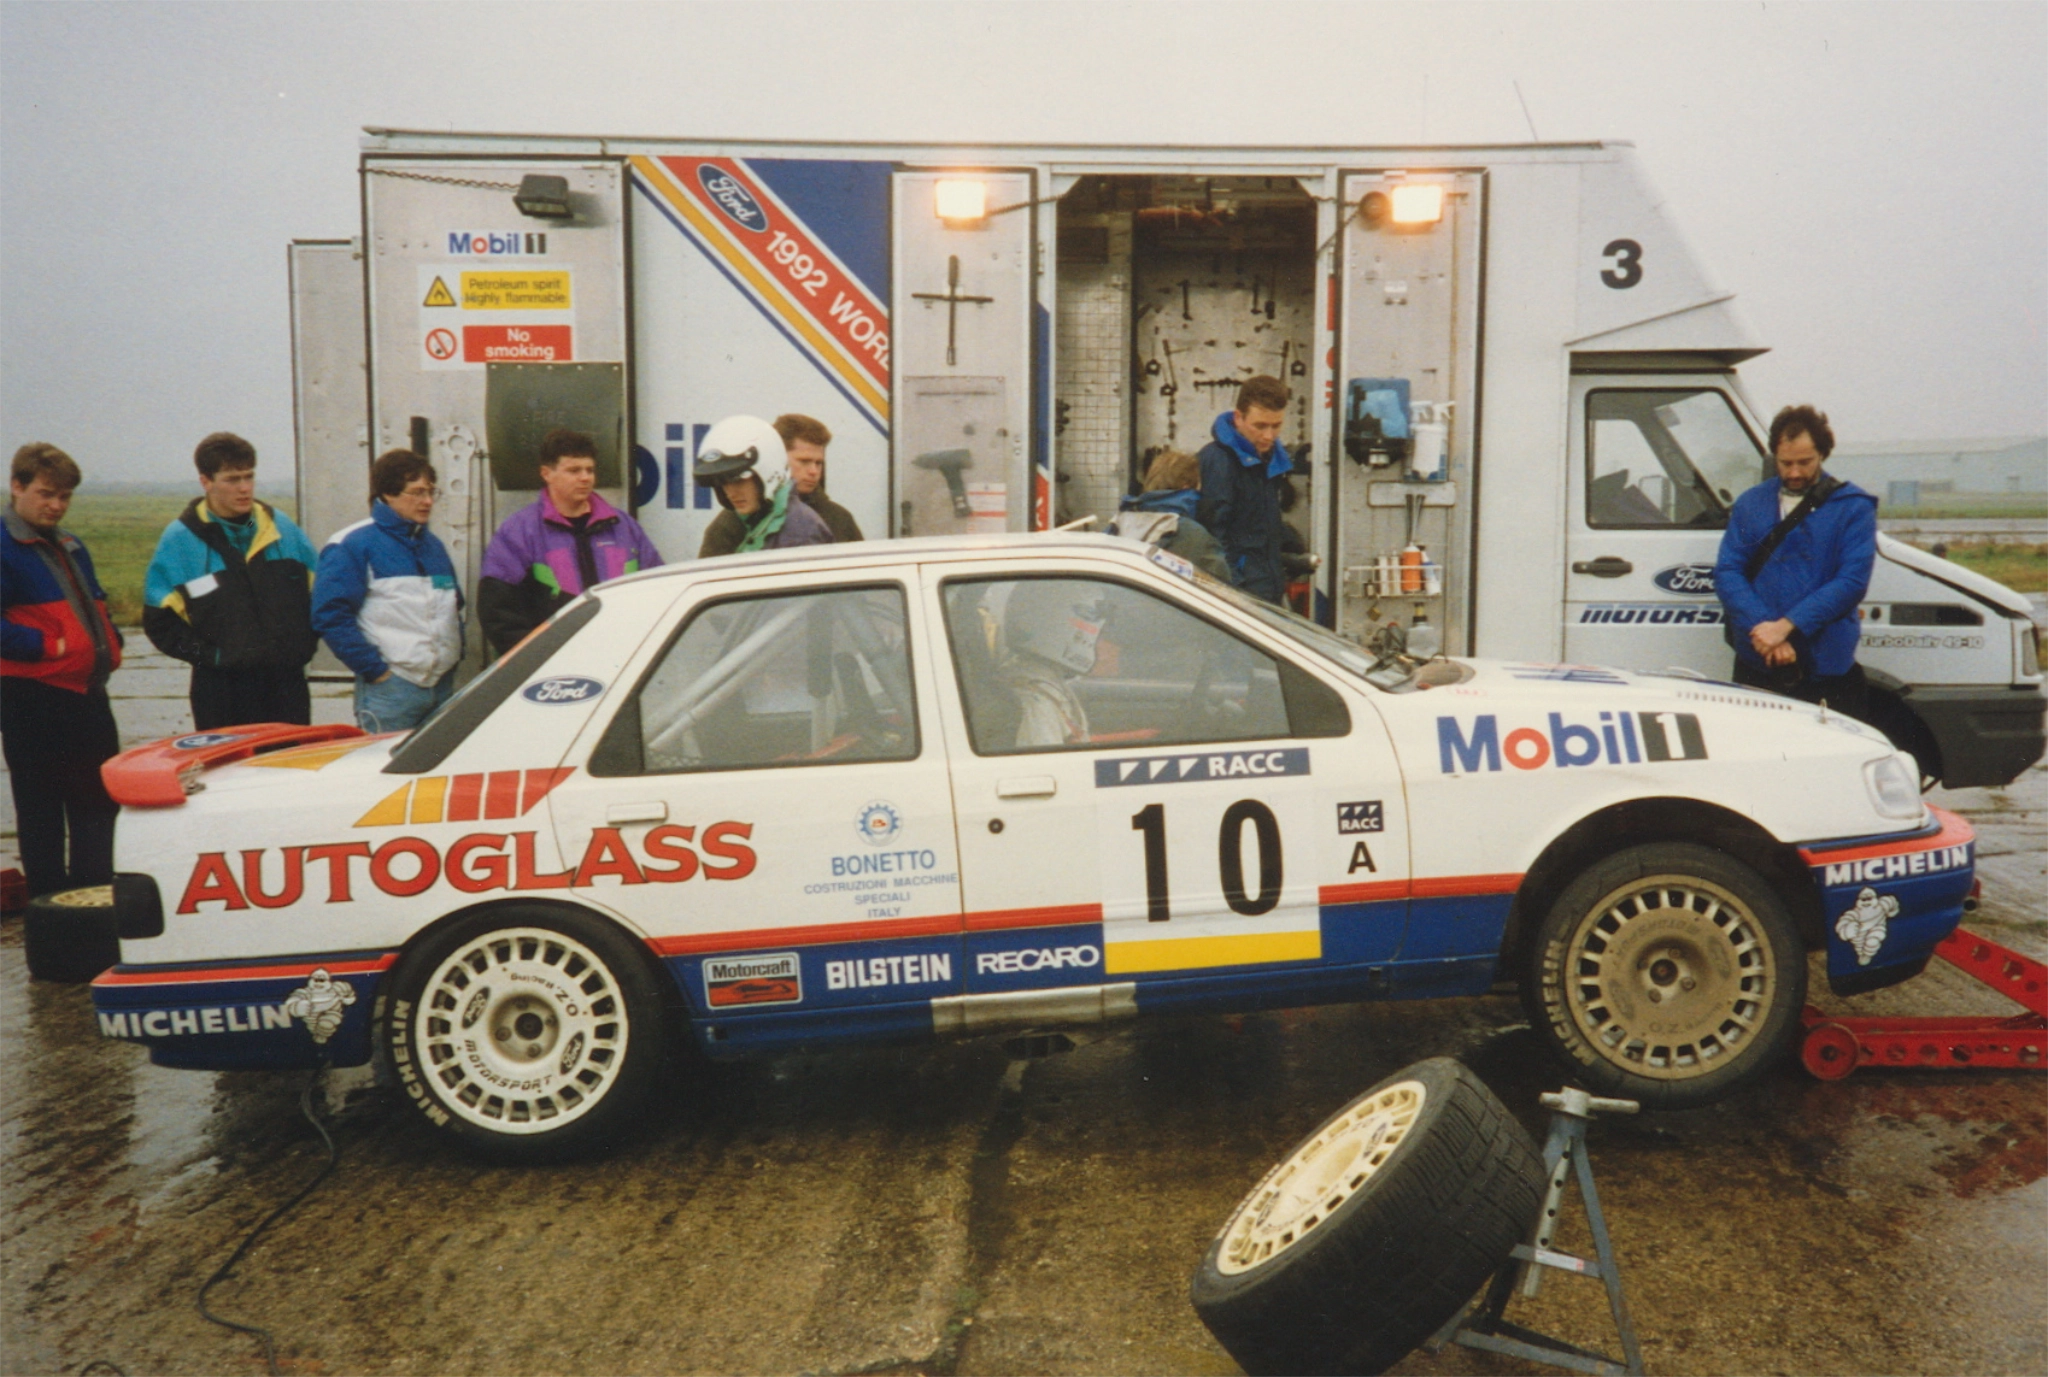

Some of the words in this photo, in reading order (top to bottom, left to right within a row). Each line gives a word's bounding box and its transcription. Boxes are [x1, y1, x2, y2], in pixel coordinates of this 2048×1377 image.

[448, 232, 519, 254] Mobil
[766, 229, 828, 297] 1992
[1600, 238, 1643, 290] 3
[468, 278, 528, 290] Petroleum
[533, 279, 562, 291] spirit
[506, 292, 566, 303] flammable
[507, 328, 530, 342] No
[485, 344, 555, 360] smoking
[536, 679, 590, 701] Ford
[1436, 711, 1641, 774] Mobil
[1207, 751, 1286, 777] RACC
[1340, 816, 1381, 831] RACC
[176, 821, 758, 915] AUTOGLASS
[831, 849, 936, 877] BONETTO
[1131, 798, 1283, 923] 10
[1347, 841, 1377, 875] A
[1825, 845, 1969, 888] MICHELIN
[804, 878, 888, 895] COSTRUZIONI
[893, 873, 959, 888] MACCHINE
[854, 891, 911, 905] SPECIALI
[867, 907, 902, 918] ITALY
[711, 959, 792, 980] Motorcraft
[825, 953, 952, 990] BILSTEIN
[976, 944, 1101, 975] RECARO
[98, 1004, 293, 1038] MICHELIN
[392, 999, 450, 1127] MICHELIN
